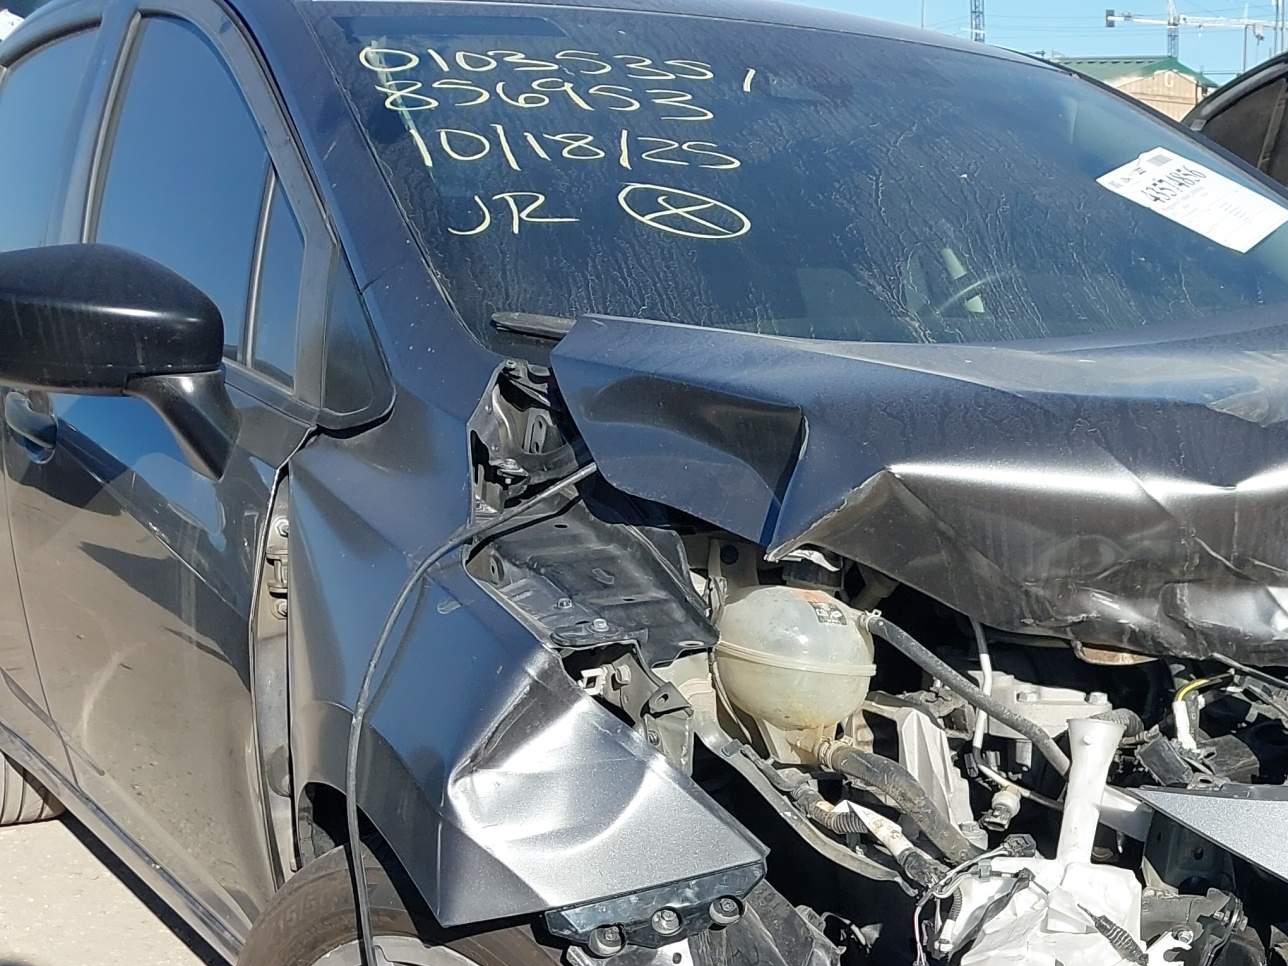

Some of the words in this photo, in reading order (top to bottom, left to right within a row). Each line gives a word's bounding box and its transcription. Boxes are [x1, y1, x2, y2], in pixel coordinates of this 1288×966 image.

[358, 46, 714, 80] 0103535
[374, 78, 715, 121] 856953
[408, 123, 742, 171] 10/18/25
[447, 191, 580, 236] JR
